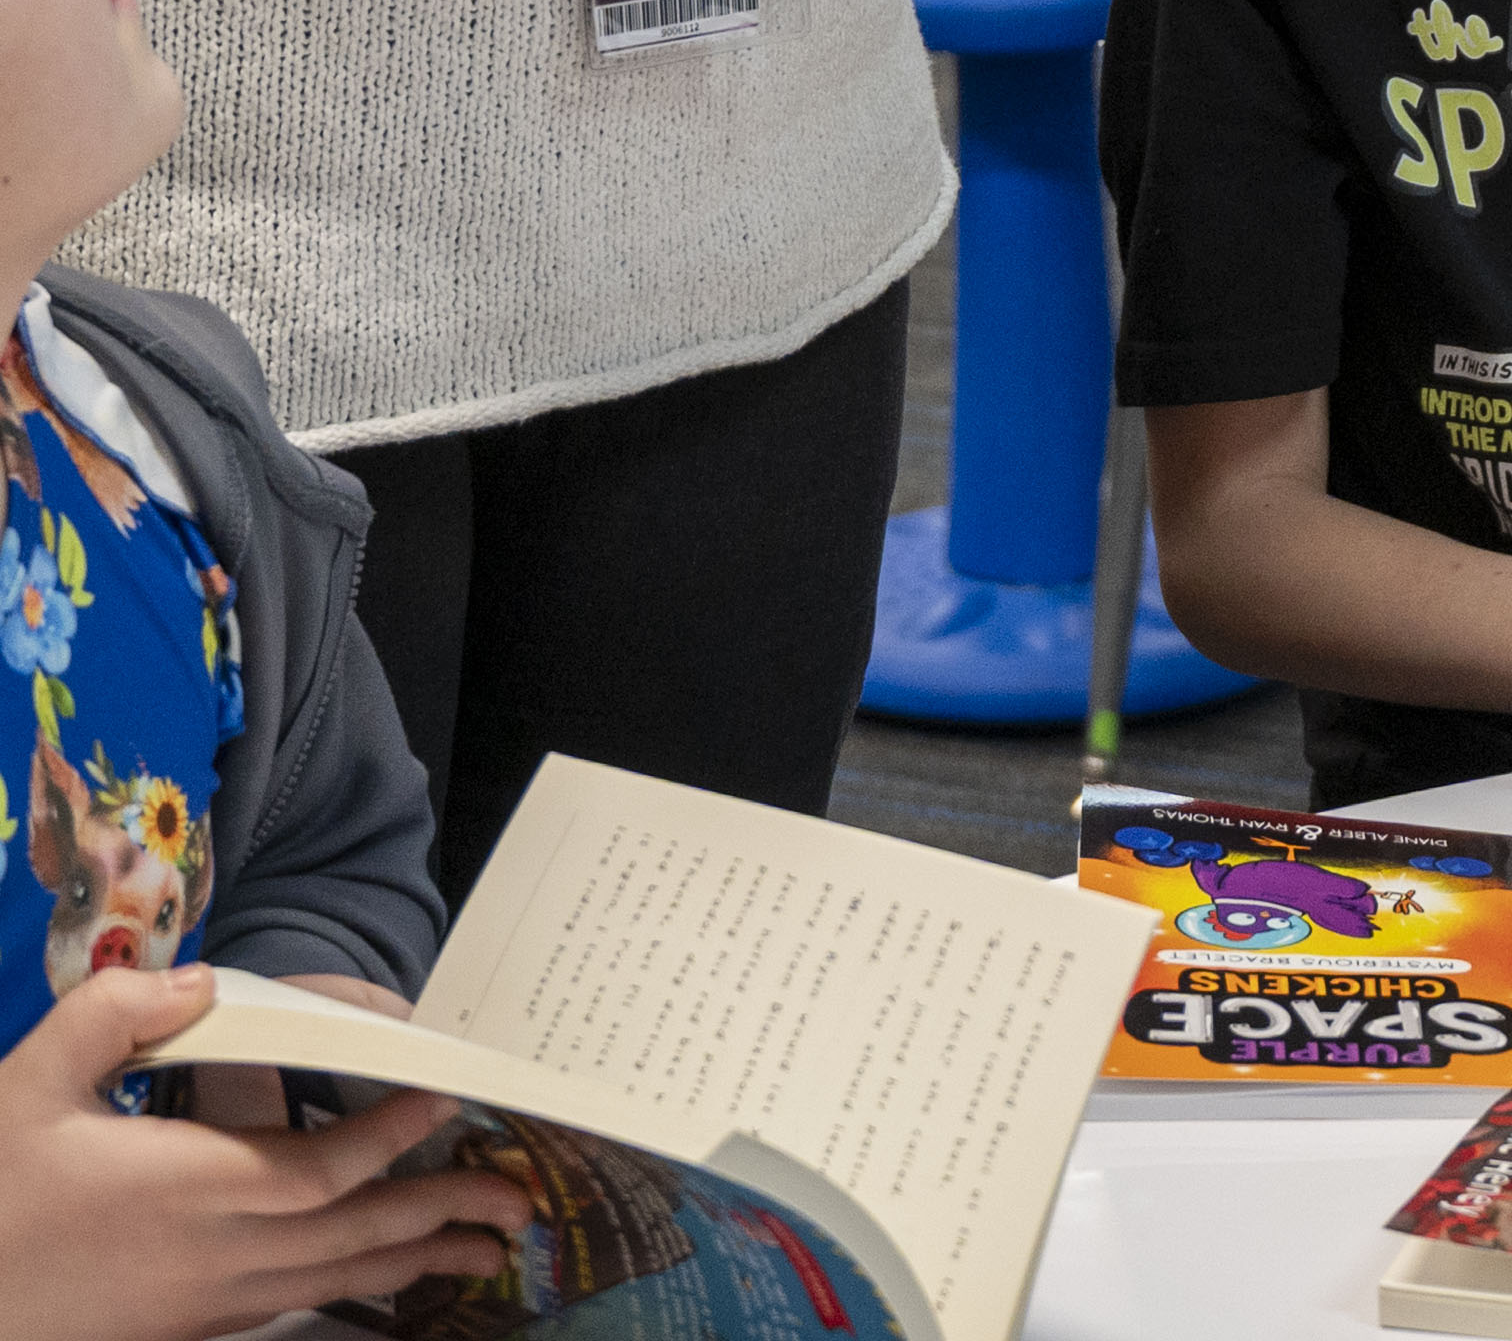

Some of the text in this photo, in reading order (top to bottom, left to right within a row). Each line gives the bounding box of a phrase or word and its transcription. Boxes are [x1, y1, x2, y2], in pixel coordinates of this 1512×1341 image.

[1438, 354, 1458, 371] IN
[1459, 354, 1489, 377] THIS
[1446, 421, 1496, 453] THE
[1152, 808, 1448, 848] DIANE ALBER & RYAN THOMAS
[1167, 949, 1455, 975] MYSTERIOUS BRACELET
[1187, 964, 1447, 1003] CHICKENS
[1143, 985, 1511, 1054] SPACE
[1228, 1036, 1432, 1065] PURPLE
